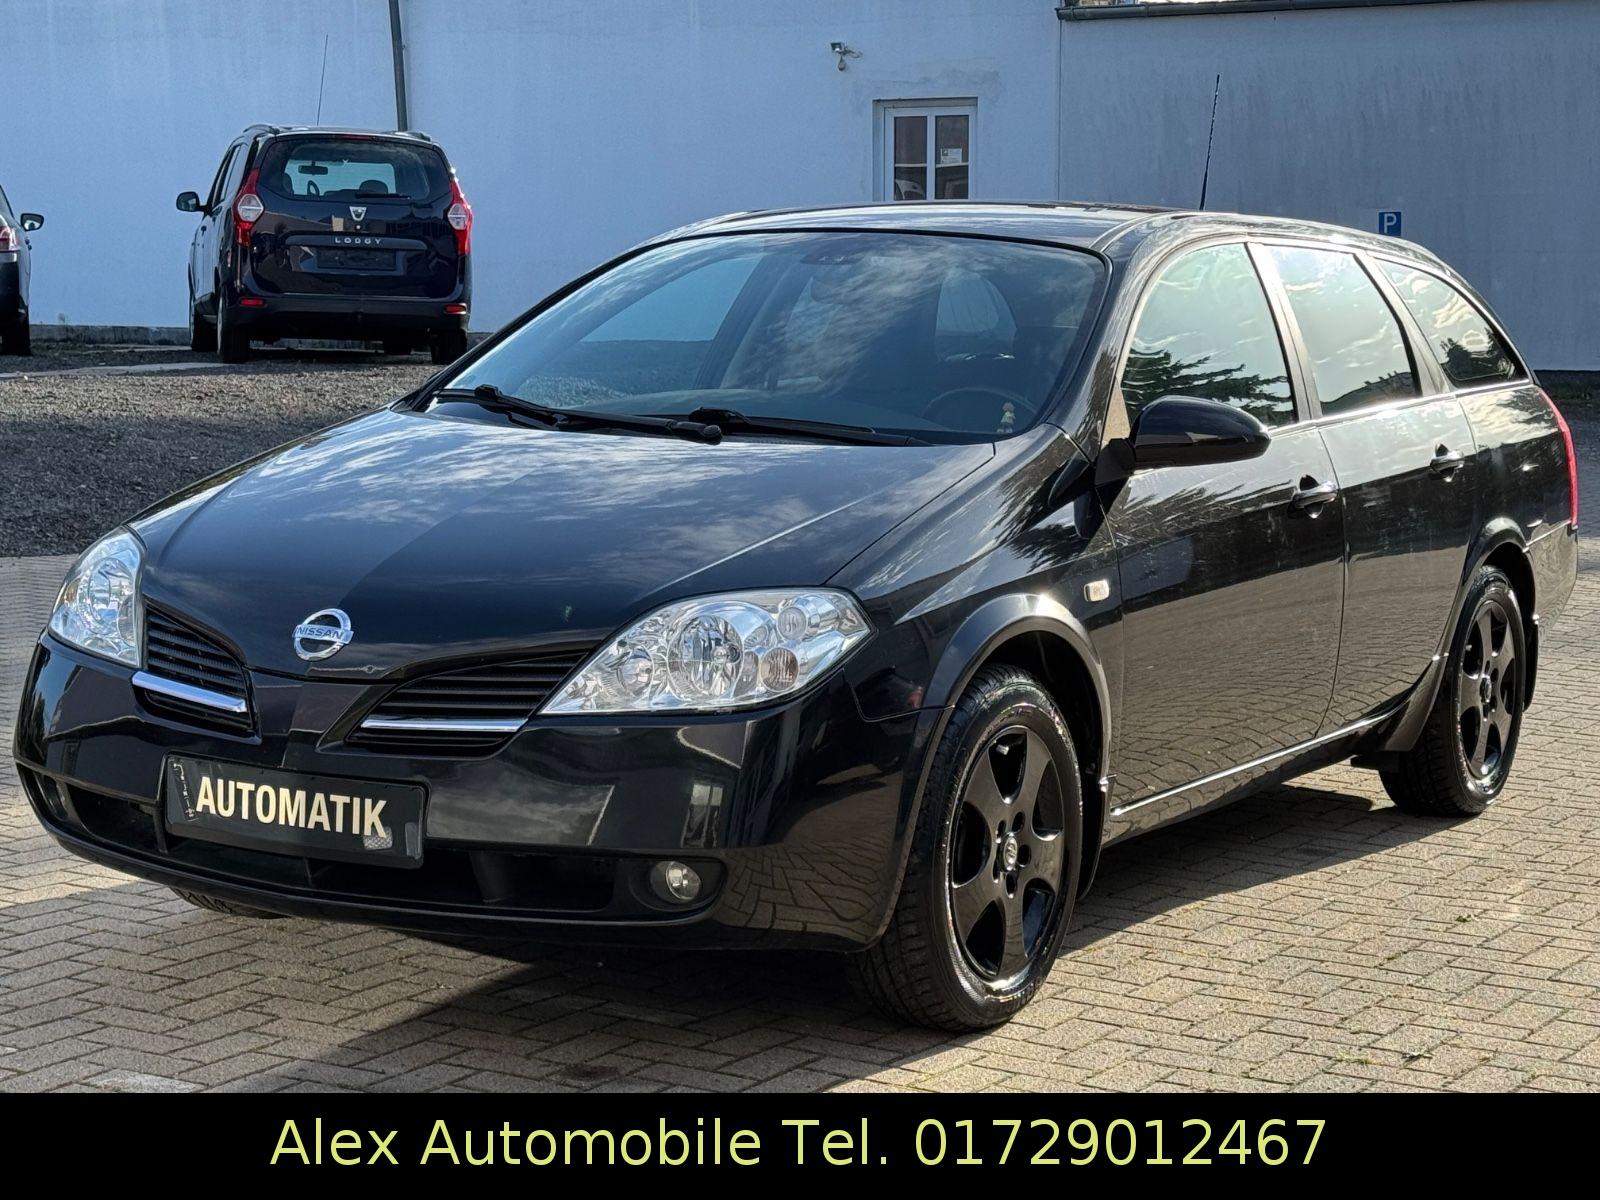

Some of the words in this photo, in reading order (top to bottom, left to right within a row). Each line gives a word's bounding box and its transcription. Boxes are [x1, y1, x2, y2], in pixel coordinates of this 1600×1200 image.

[1383, 213, 1397, 234] P
[335, 237, 382, 245] LODGY
[296, 626, 345, 640] NISSAN
[195, 776, 388, 839] AUTOMATIK
